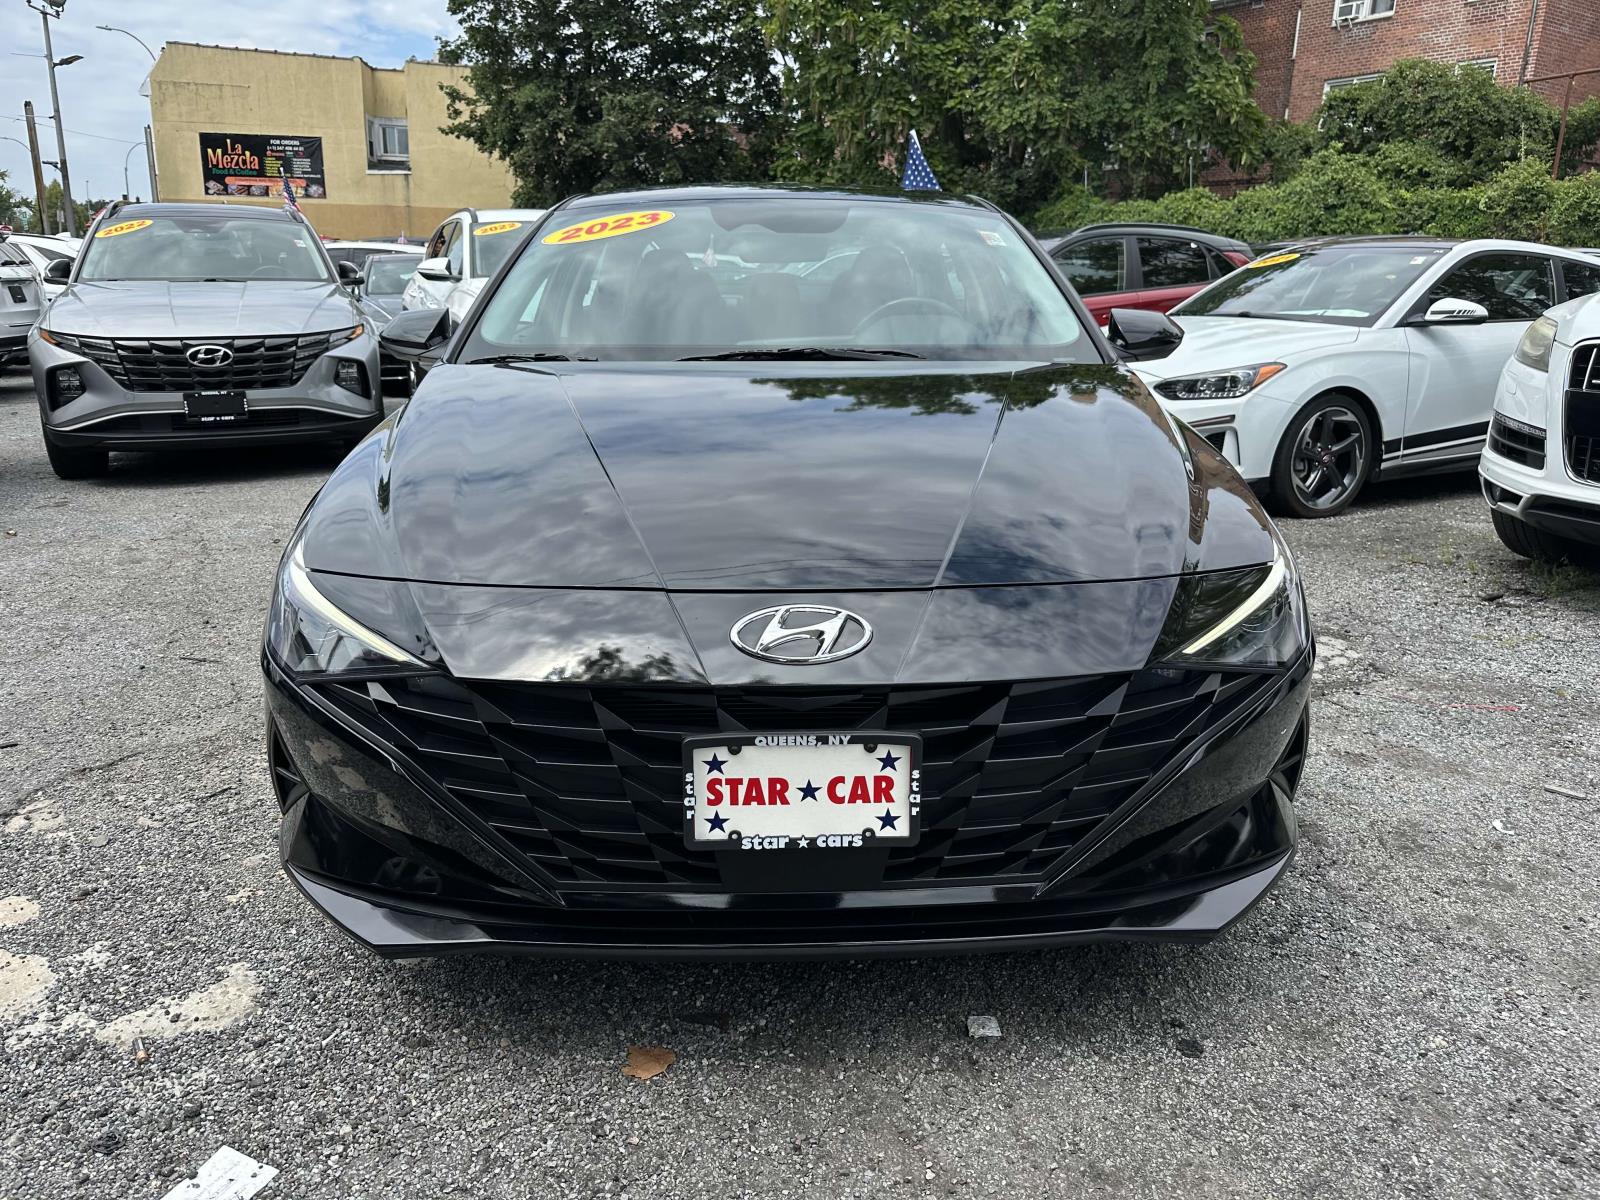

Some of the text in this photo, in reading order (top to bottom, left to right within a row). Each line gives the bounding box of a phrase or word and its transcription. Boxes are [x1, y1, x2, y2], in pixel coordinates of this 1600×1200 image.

[226, 139, 242, 154] La
[207, 148, 259, 170] Mezcla
[104, 221, 146, 236] 2022
[480, 223, 516, 234] 2022
[558, 212, 660, 242] 2023
[754, 735, 852, 747] QUEENS, NY
[706, 775, 895, 806] STAR CAR
[741, 833, 863, 850] star cars
